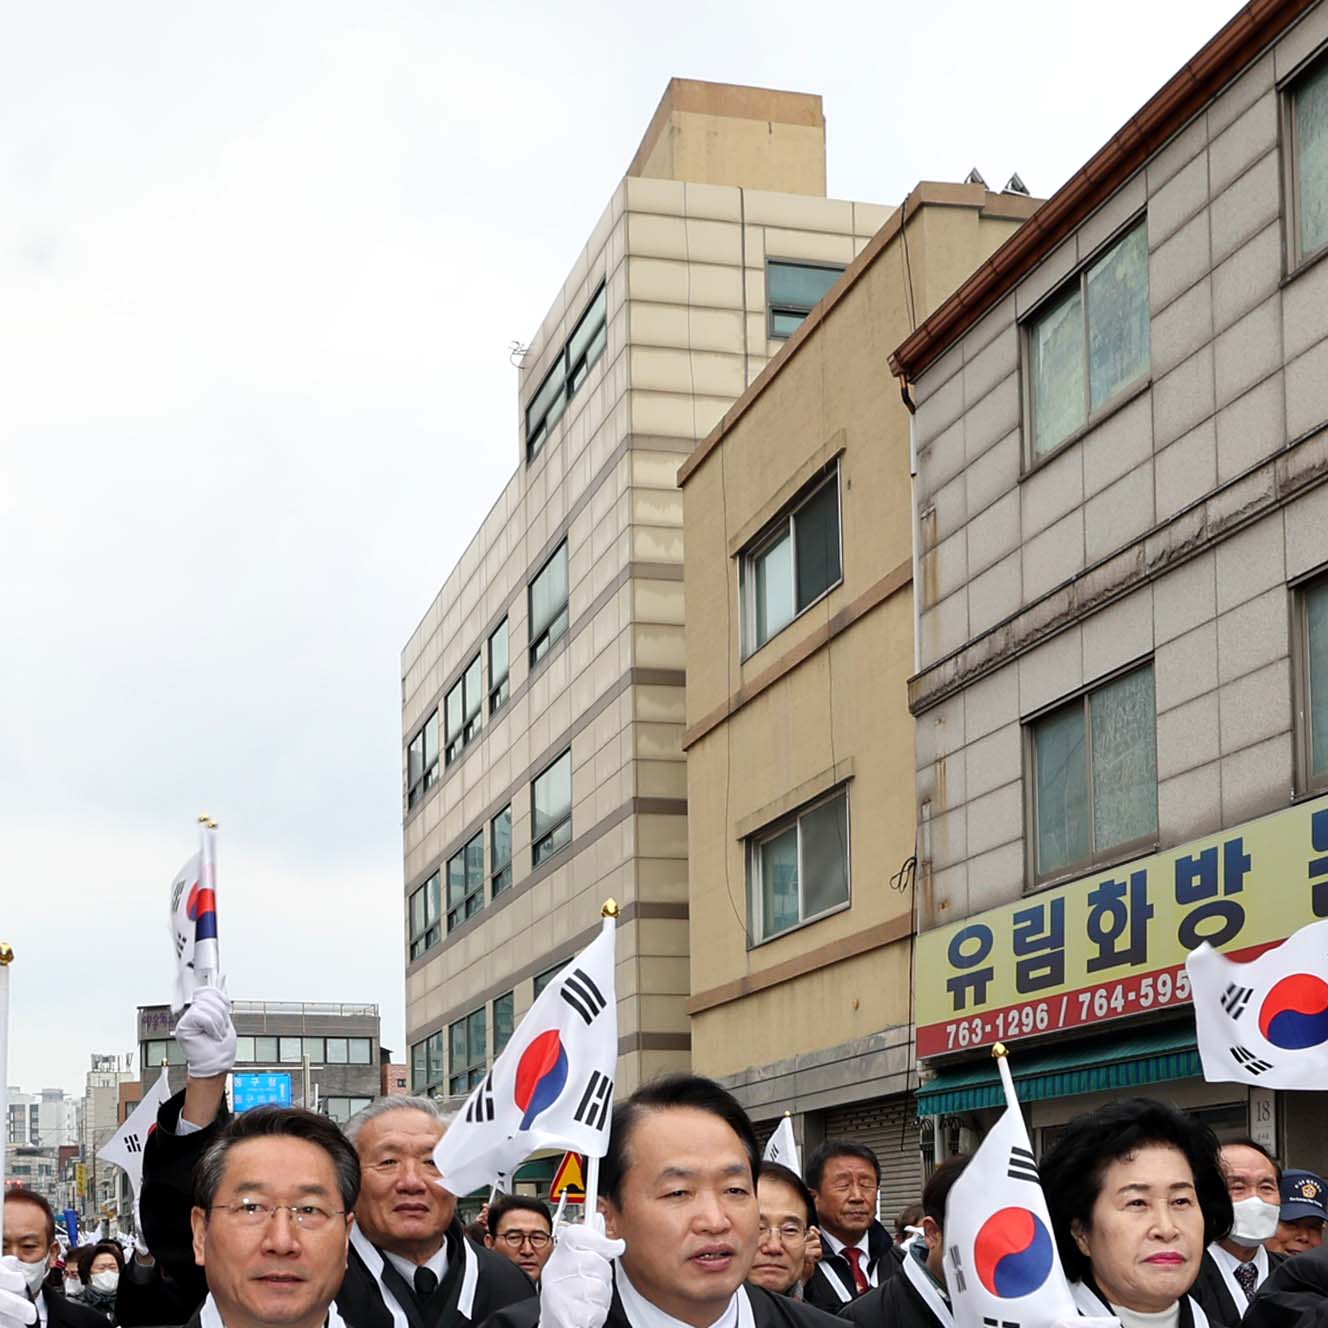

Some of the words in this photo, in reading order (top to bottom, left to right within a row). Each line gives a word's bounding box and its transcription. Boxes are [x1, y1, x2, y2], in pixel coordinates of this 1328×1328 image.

[947, 837, 1251, 1011] 유림화방
[946, 1001, 1049, 1049] 763-1296
[1256, 1100, 1271, 1122] 18
